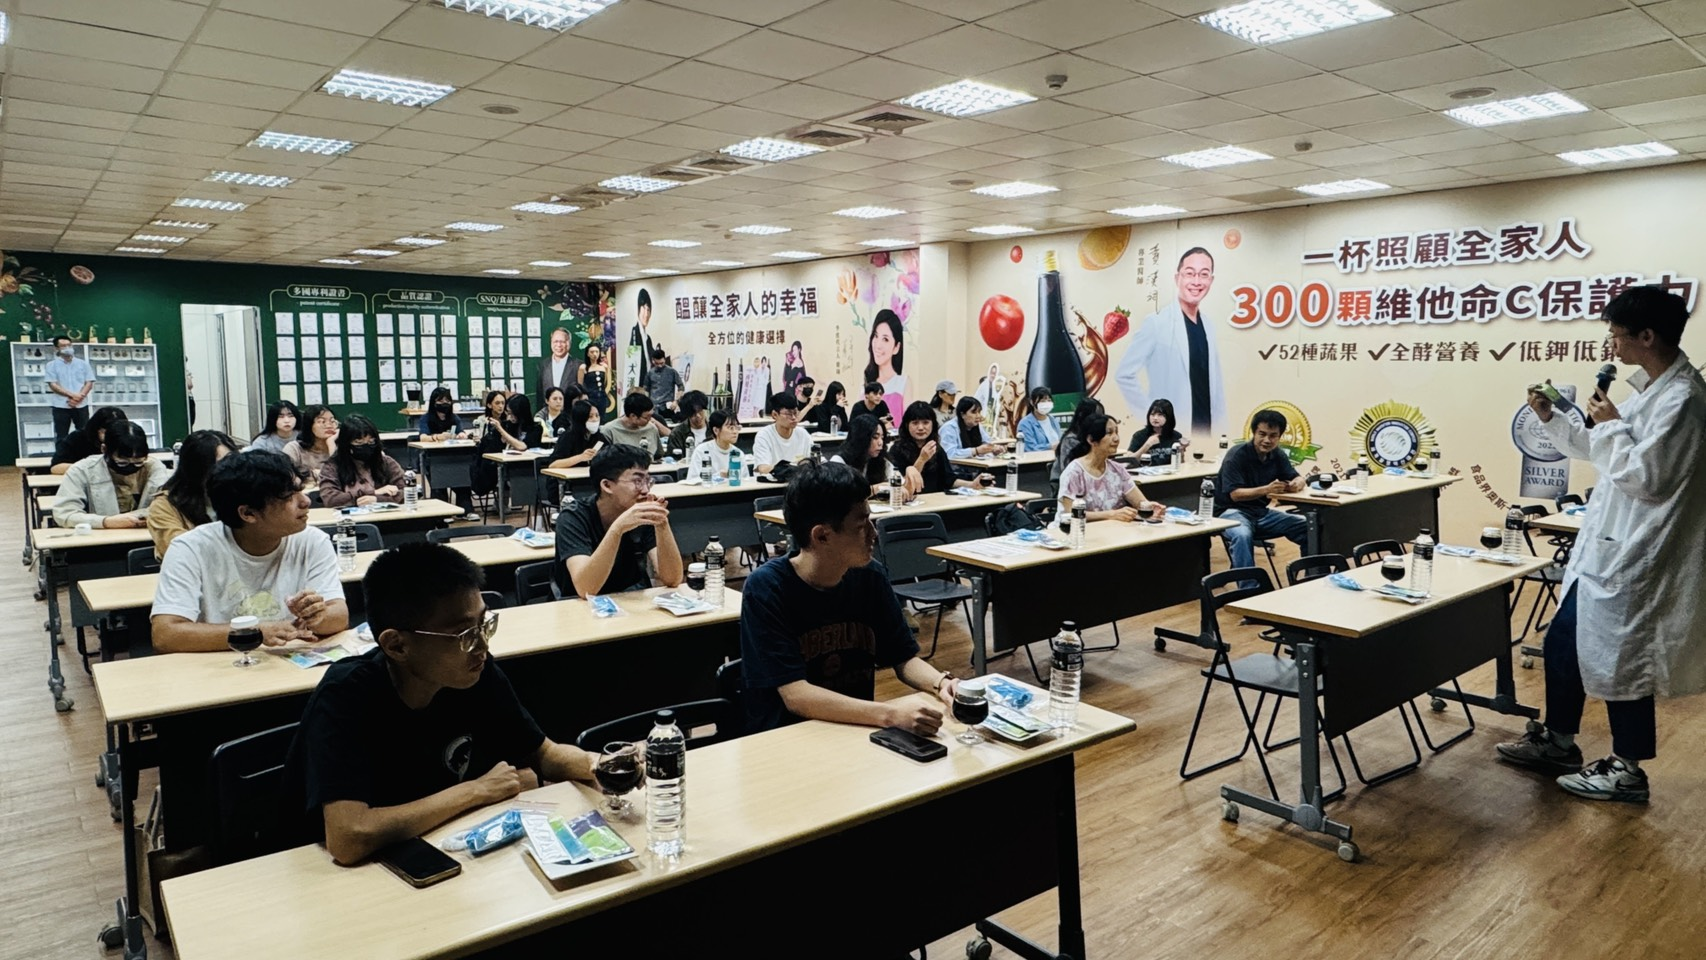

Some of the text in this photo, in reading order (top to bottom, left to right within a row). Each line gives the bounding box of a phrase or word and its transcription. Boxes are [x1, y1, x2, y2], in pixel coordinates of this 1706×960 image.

[1304, 221, 1585, 269] 一杯照顧全家人
[293, 286, 346, 298] 多國專利證書
[400, 291, 433, 301] 品質認證
[675, 287, 818, 320] 醞釀全家人的幸福
[708, 329, 786, 346] 全方位的健康選擇
[1279, 342, 1358, 361] 52種蔬果
[1389, 341, 1481, 362] 全酵營養
[1525, 466, 1566, 478] SILVER
[1470, 464, 1511, 511] 食品界奧斯
[1525, 477, 1565, 487] AWARD
